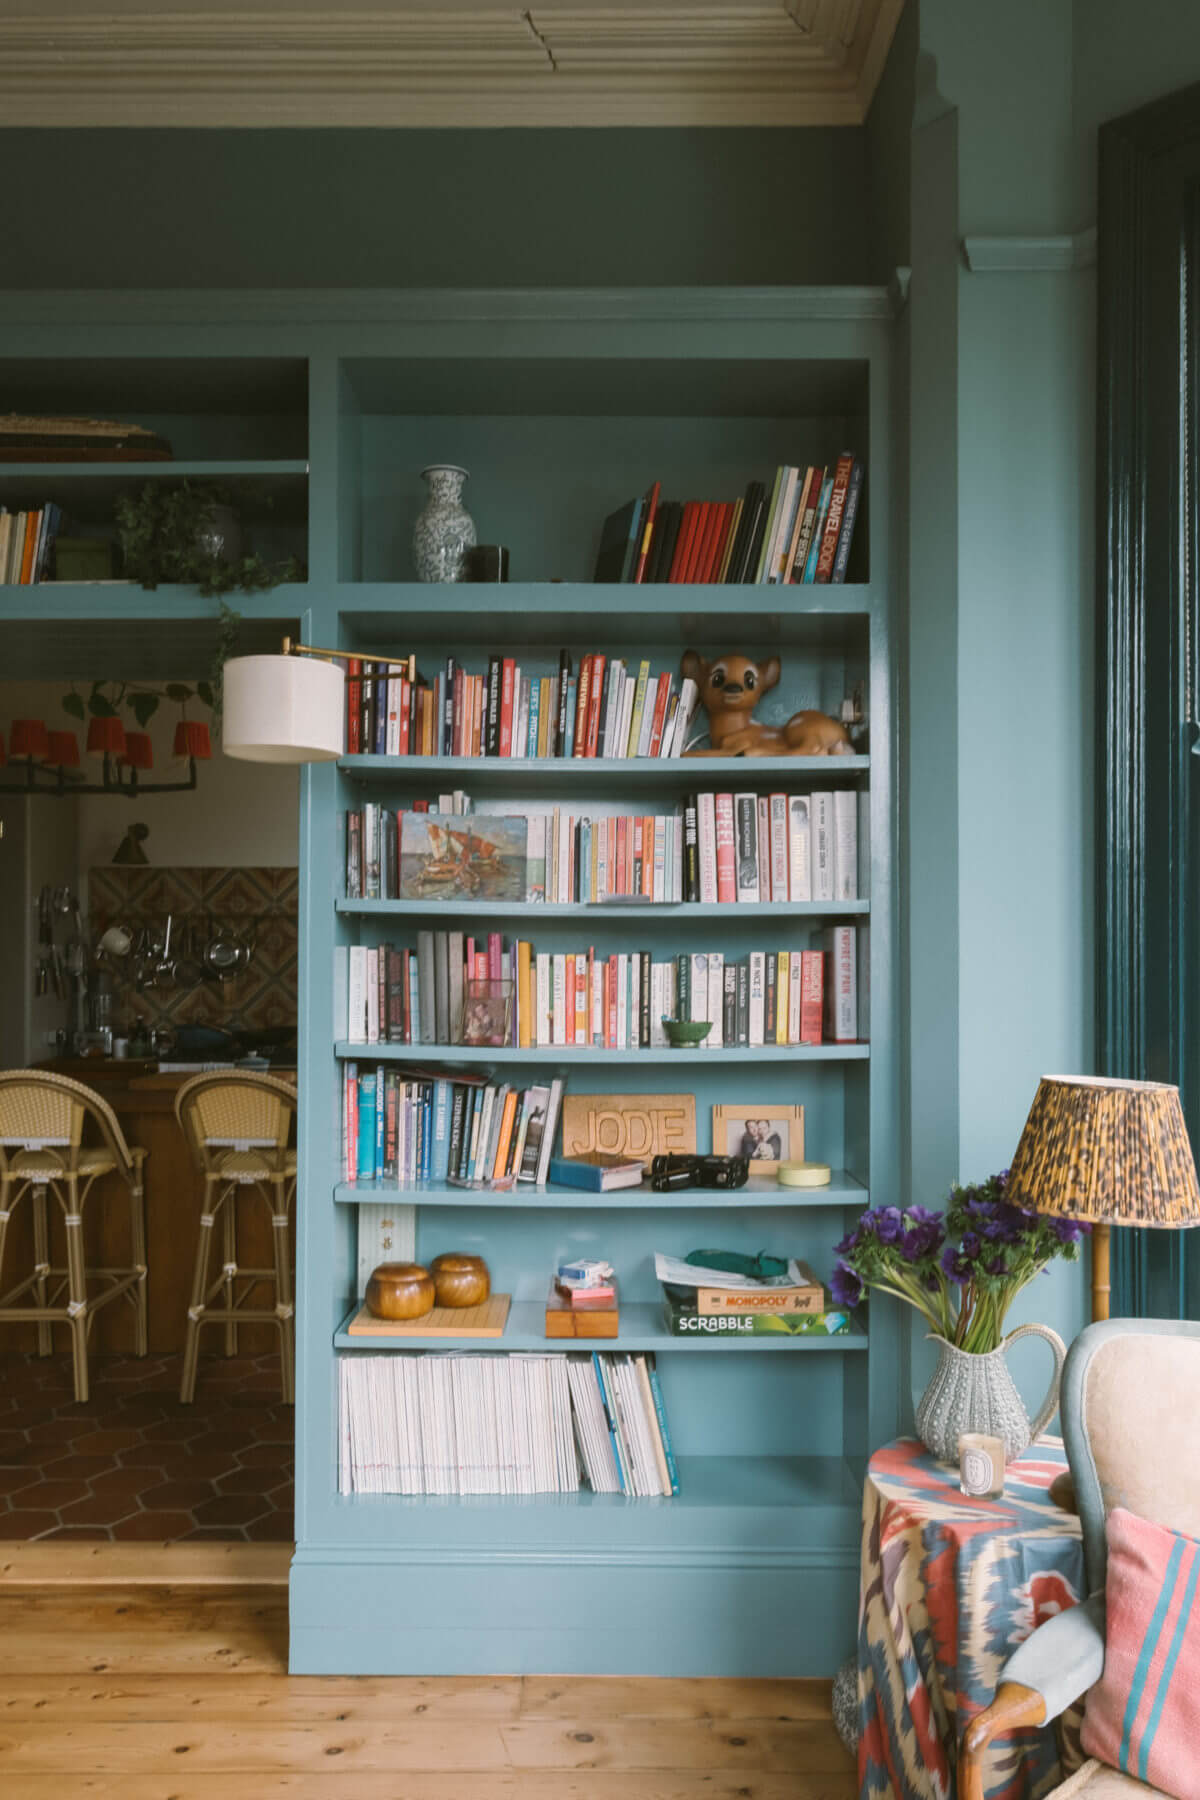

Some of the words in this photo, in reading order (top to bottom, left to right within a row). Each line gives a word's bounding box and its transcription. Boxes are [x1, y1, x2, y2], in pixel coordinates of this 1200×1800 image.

[836, 460, 853, 488] THE
[826, 488, 847, 538] TRAVEL
[817, 536, 837, 571] BOOK
[571, 1108, 687, 1157] JODIE
[726, 1294, 788, 1307] MONOPOLY
[679, 1316, 753, 1332] SCRABBLE
